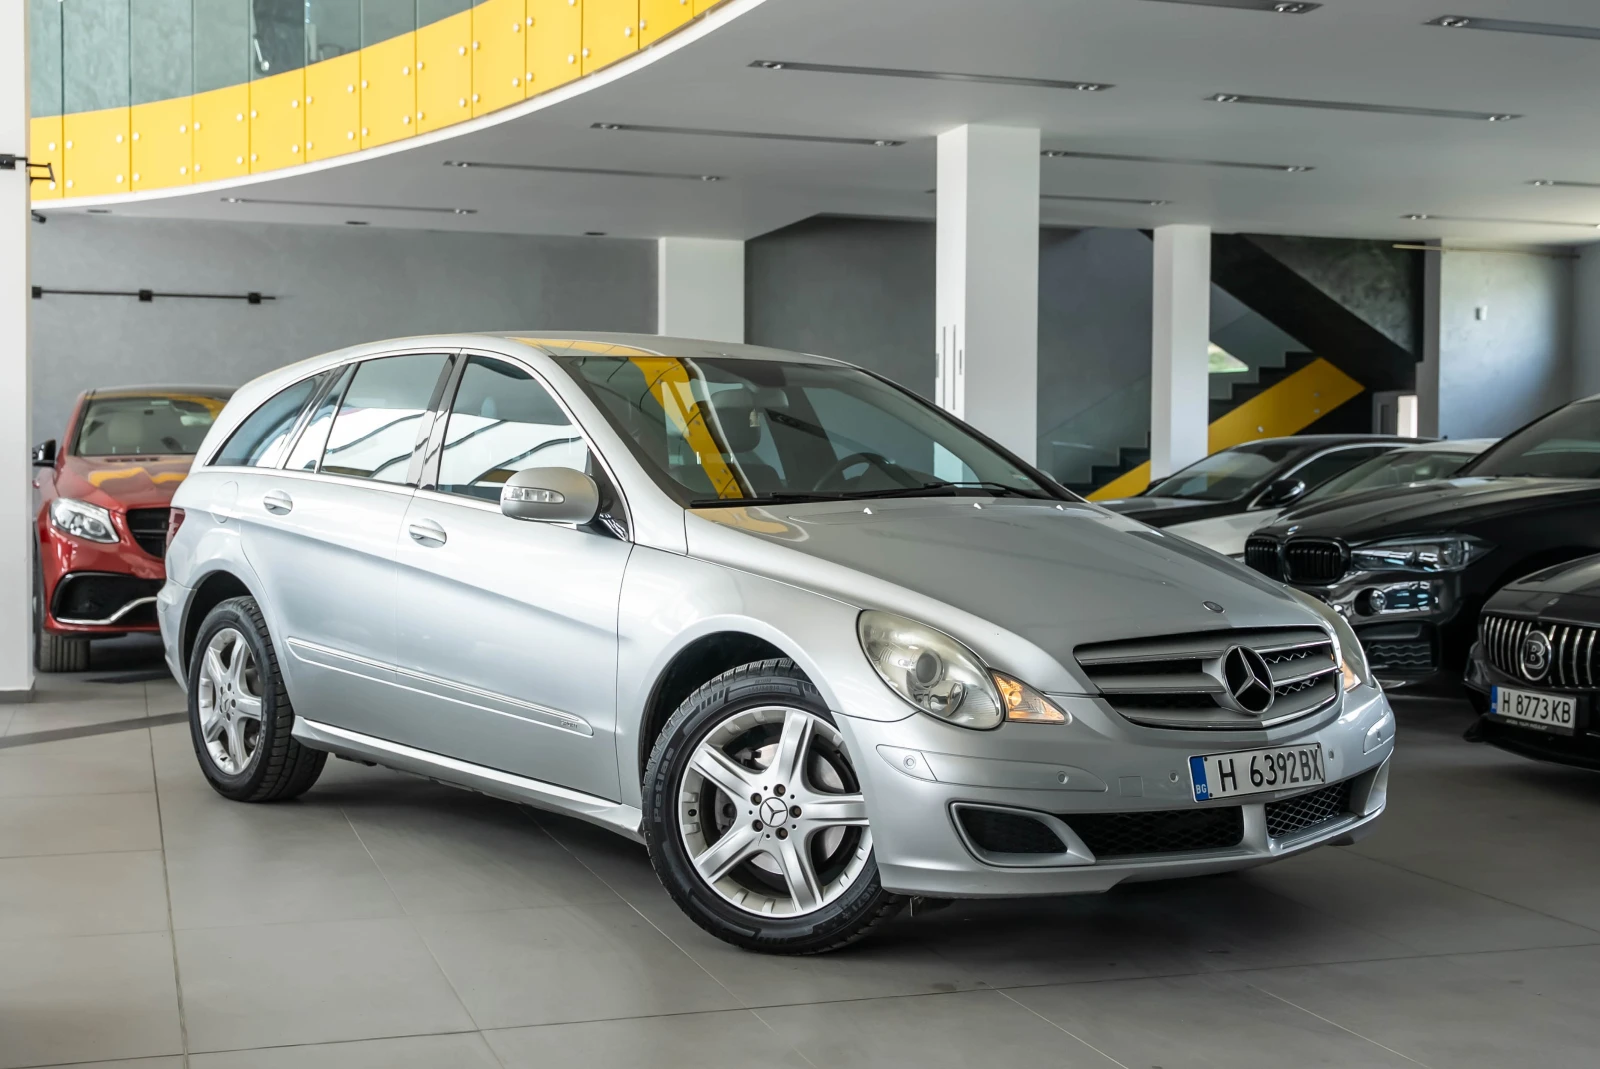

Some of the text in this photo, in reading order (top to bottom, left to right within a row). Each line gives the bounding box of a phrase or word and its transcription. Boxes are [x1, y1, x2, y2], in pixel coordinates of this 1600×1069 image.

[1524, 640, 1545, 669] B
[1503, 691, 1511, 713] H
[1218, 749, 1322, 792] H 6392BX
[1196, 784, 1207, 794] BG
